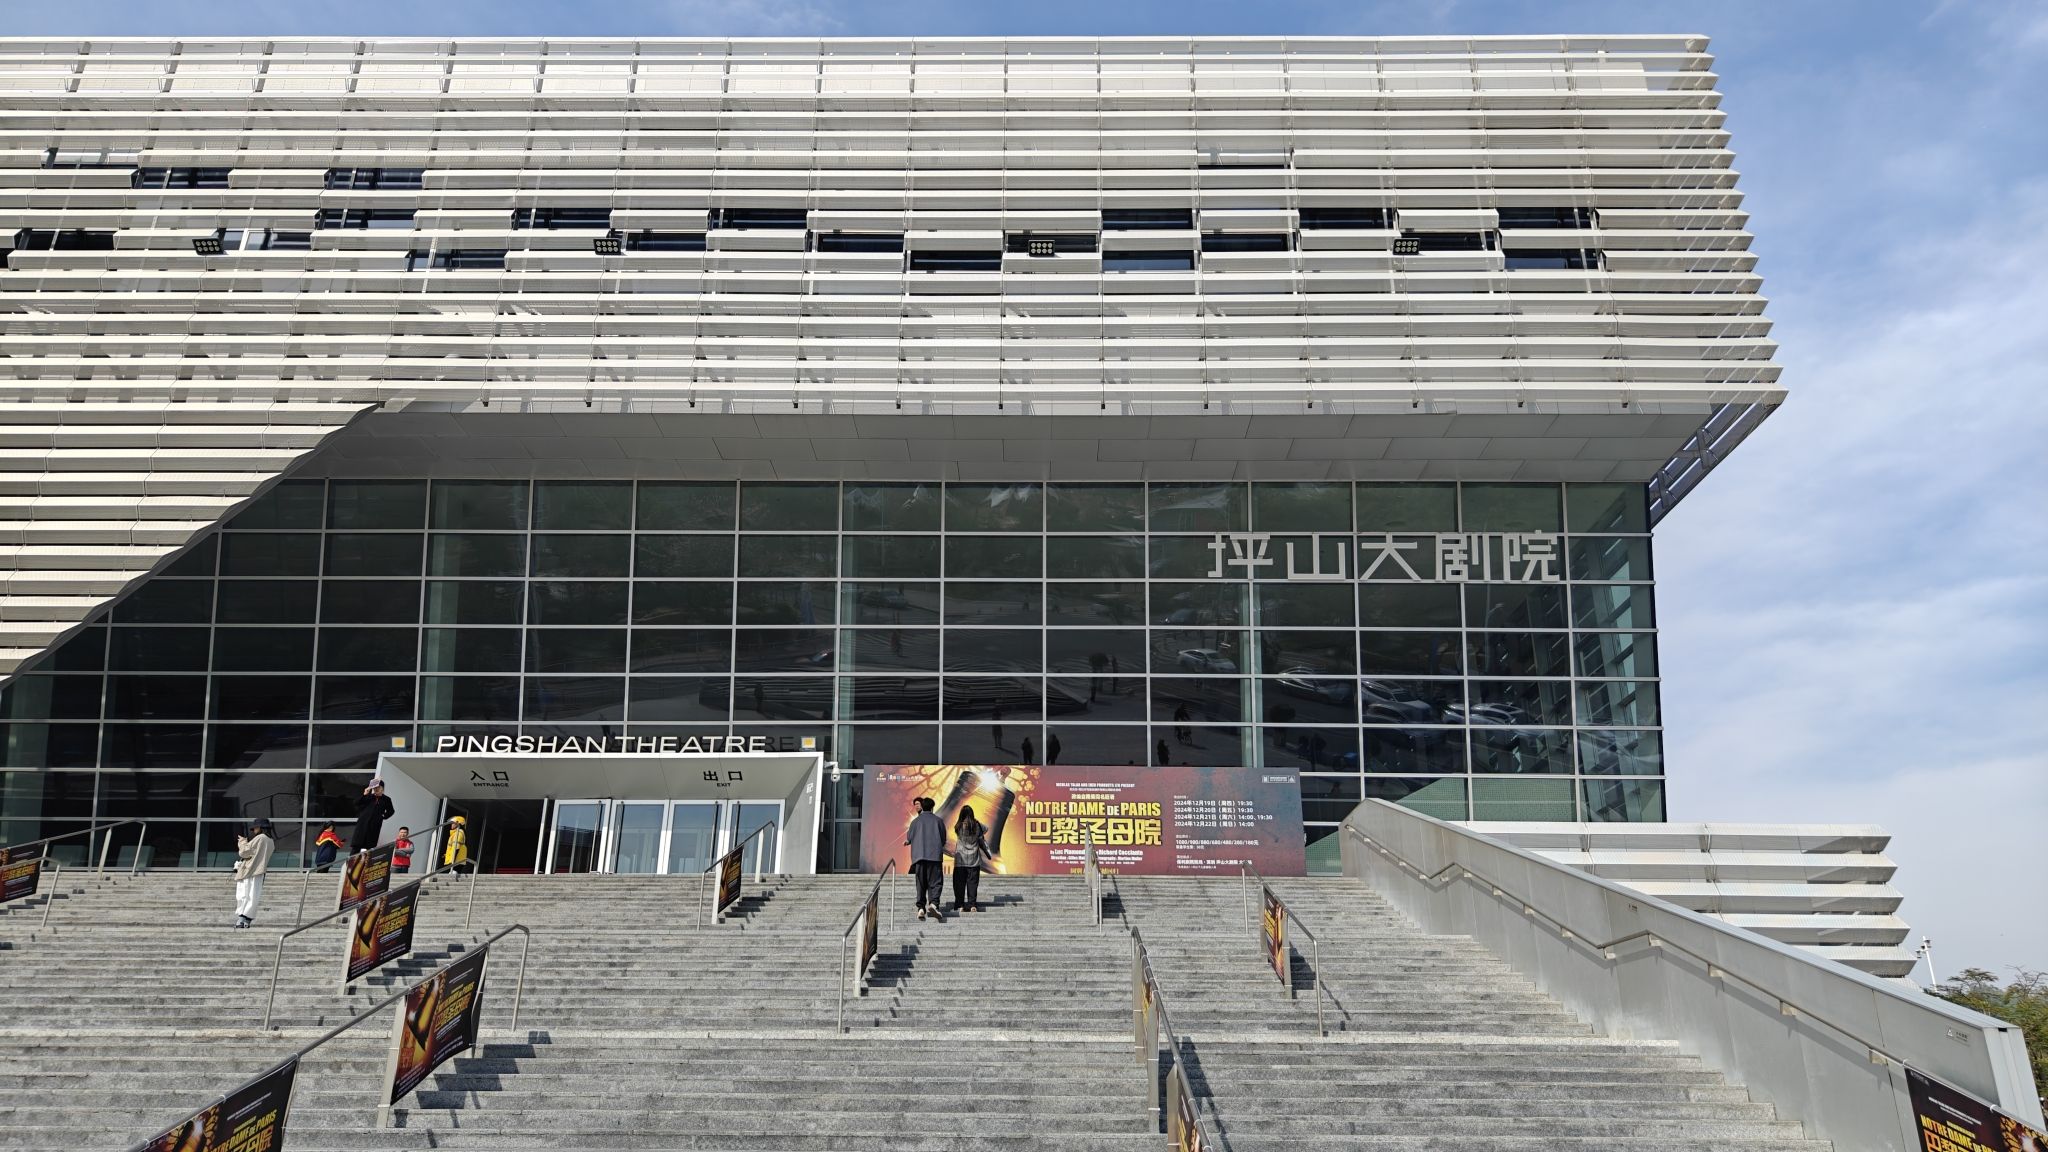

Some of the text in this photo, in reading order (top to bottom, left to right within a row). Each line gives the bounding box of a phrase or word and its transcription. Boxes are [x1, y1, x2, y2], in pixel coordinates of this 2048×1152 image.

[1207, 530, 1560, 583] 坪山大剧院
[437, 735, 767, 753] PINGSHAN THEATRE
[470, 770, 509, 781] 入口
[703, 770, 743, 781] 出口
[1026, 801, 1161, 817] NOTRE DAME DE PARIS
[1025, 817, 1162, 846] 巴黎圣母院
[1920, 1114, 1948, 1138] NOTRE
[1947, 1127, 1974, 1151] DAME
